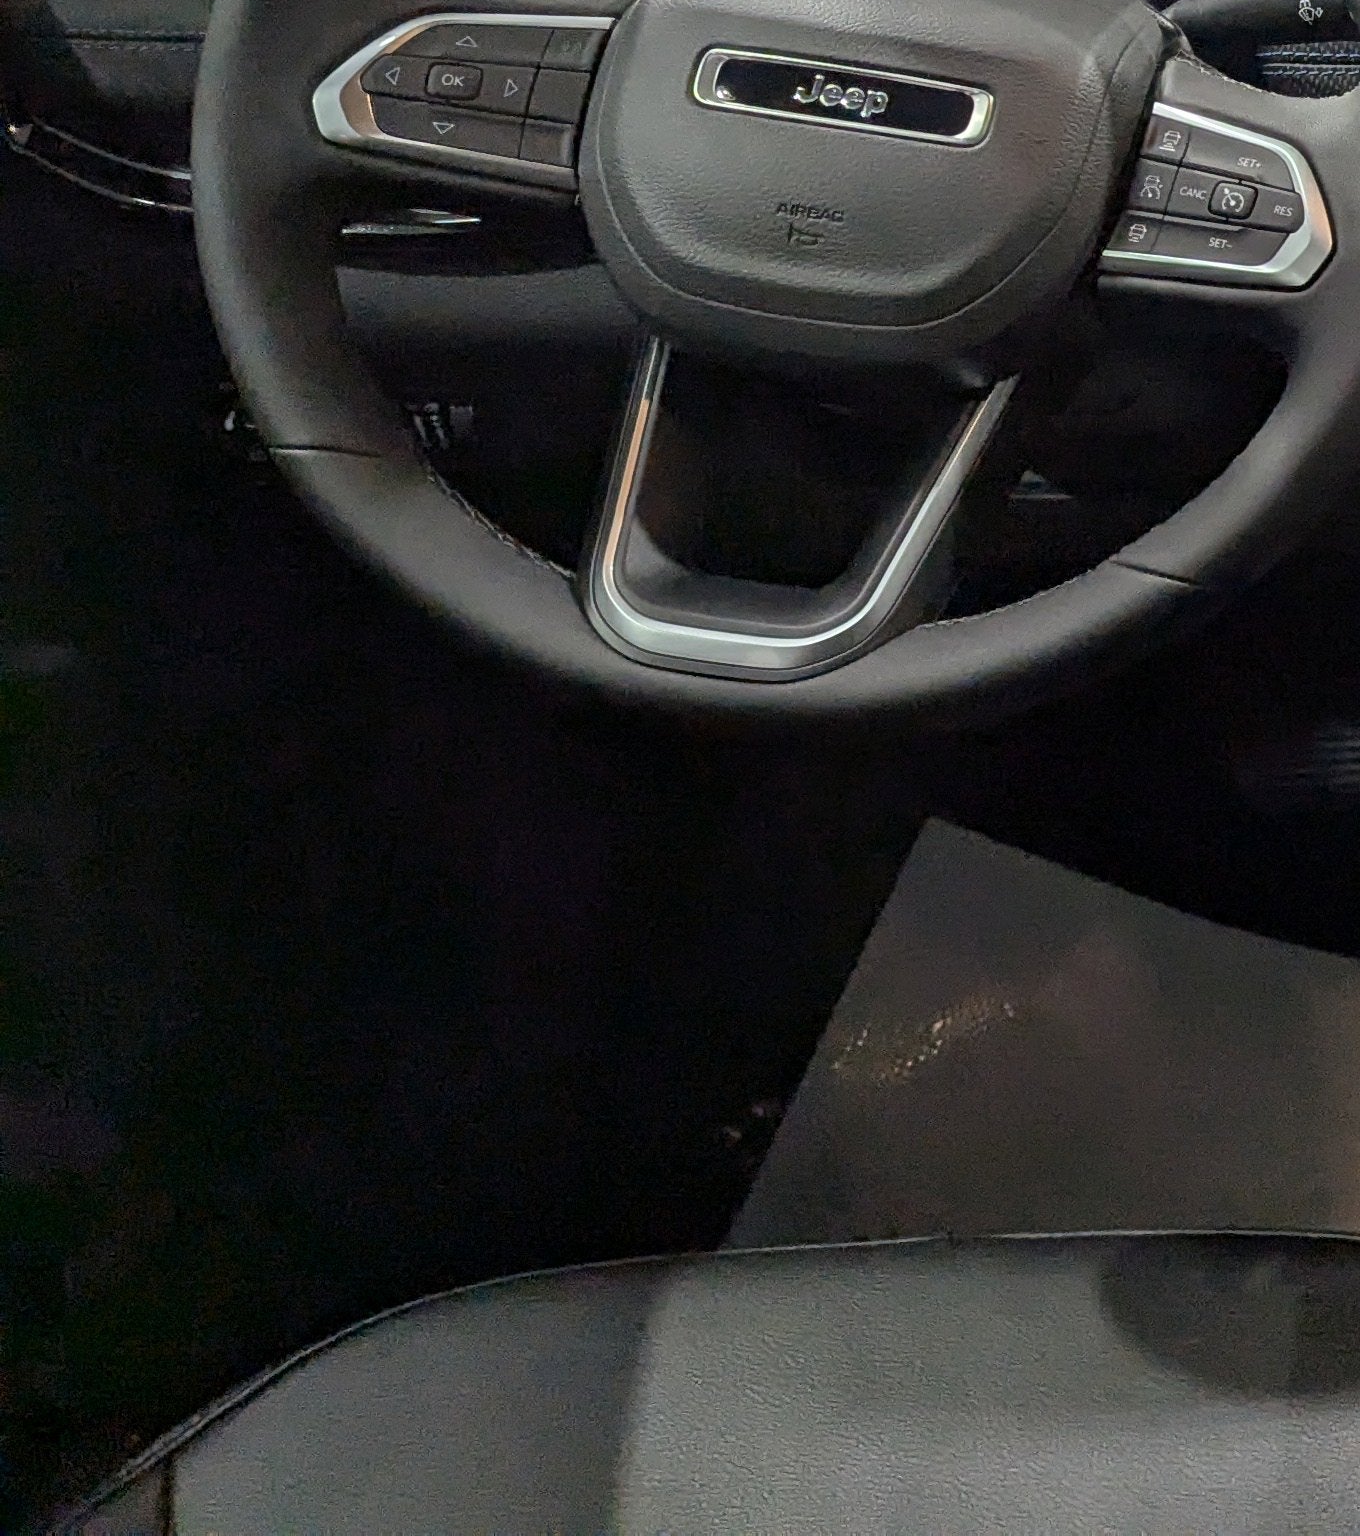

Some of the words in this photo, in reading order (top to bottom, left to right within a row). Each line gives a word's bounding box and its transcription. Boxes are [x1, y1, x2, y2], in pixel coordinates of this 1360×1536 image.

[441, 74, 465, 87] OK
[792, 73, 889, 118] Jeep
[1273, 204, 1293, 217] RES
